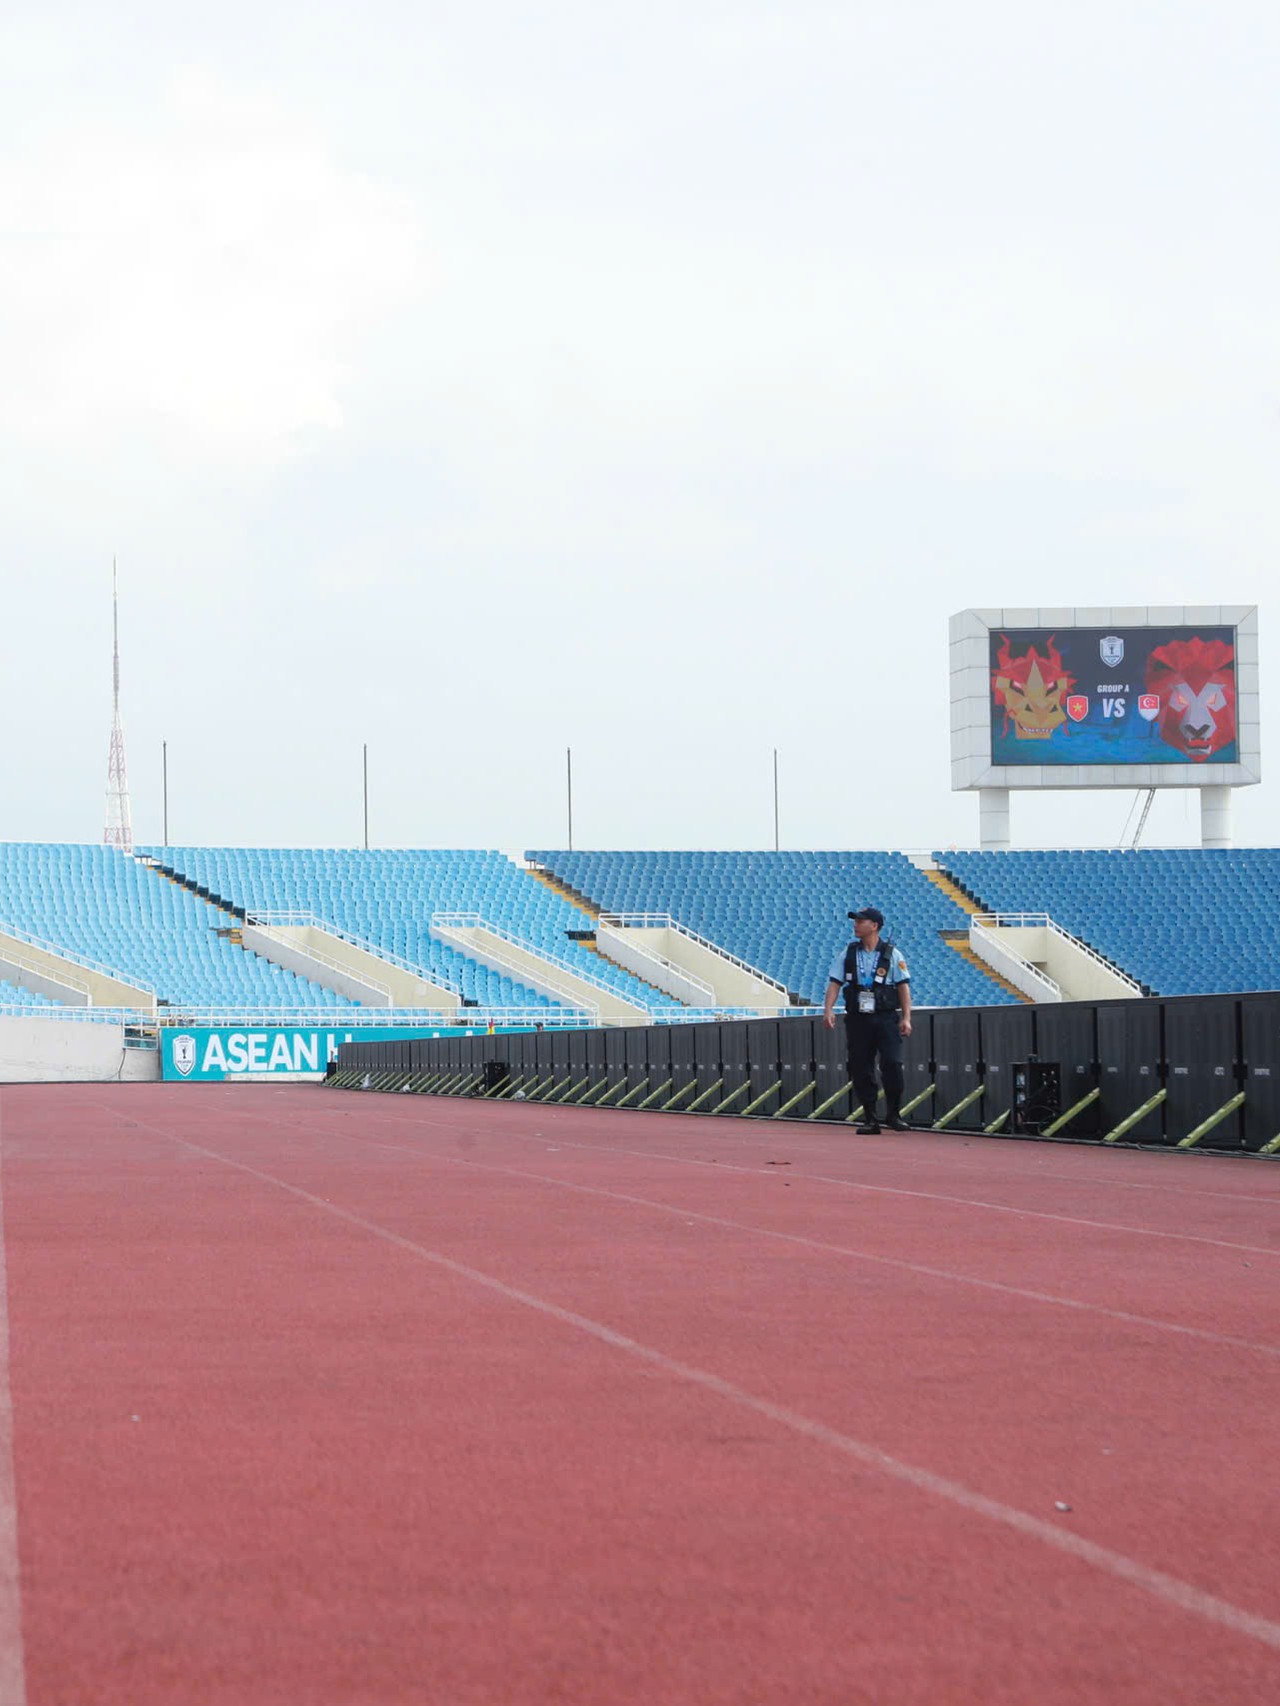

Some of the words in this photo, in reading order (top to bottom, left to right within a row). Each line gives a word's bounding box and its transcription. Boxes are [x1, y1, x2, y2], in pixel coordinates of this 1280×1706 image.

[1097, 684, 1123, 693] GROUP
[1124, 684, 1130, 693] A
[1102, 698, 1126, 718] VS
[202, 1033, 318, 1072] ASEAN
